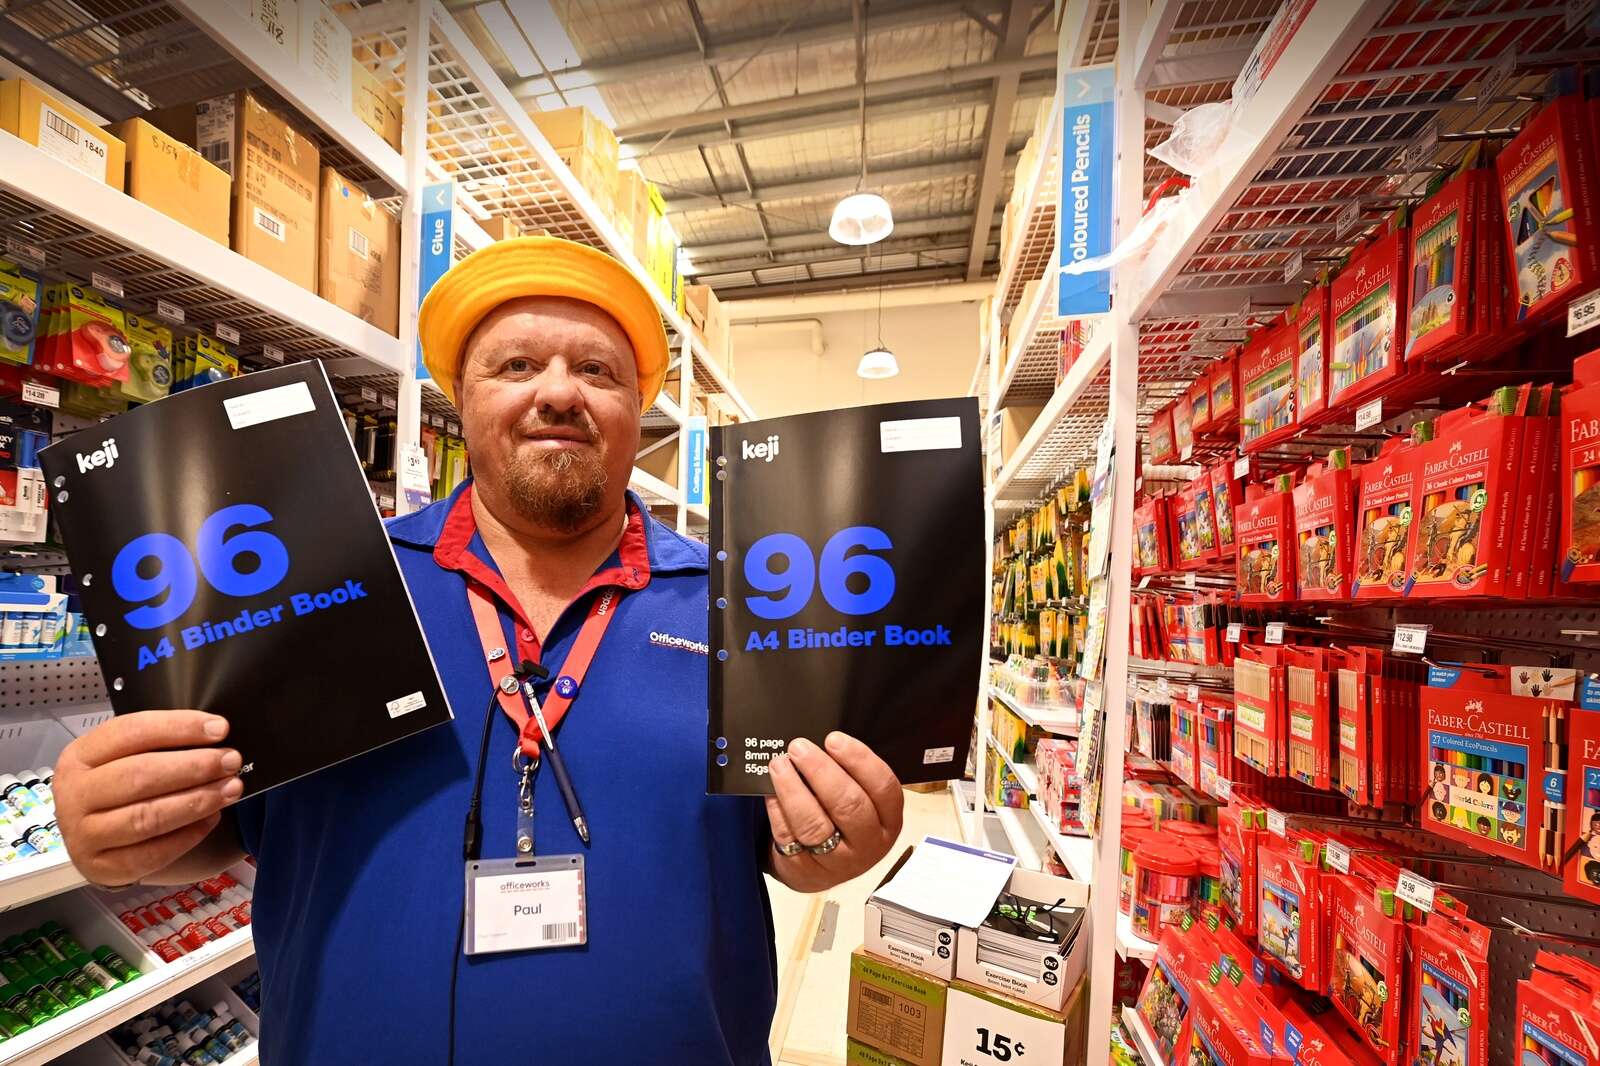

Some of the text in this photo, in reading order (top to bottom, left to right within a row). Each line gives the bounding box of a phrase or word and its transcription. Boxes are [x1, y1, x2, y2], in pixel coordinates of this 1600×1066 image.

[84, 139, 104, 158] 1840
[1069, 113, 1092, 267] oloured Pencils
[430, 218, 444, 256] Glue
[1335, 264, 1391, 315] FABER-CASTELL
[1570, 418, 1600, 443] FAB
[76, 437, 119, 474] keji
[742, 434, 780, 463] keji
[1583, 449, 1595, 463] 24
[1424, 447, 1490, 476] FABER-CASTELL
[1364, 472, 1414, 494] FABER-CASTELL
[111, 503, 290, 631] 96
[743, 526, 896, 620] 96
[137, 578, 368, 672] A4 Binder Book
[649, 631, 709, 653] Officeworks
[745, 625, 952, 651] A4 Binder Book
[1428, 708, 1530, 740] FABER-CASTELL
[744, 737, 784, 751] 96 page
[744, 750, 769, 760] 8mm
[1432, 734, 1498, 753] 27 Colored EcoPencils
[744, 763, 770, 775] 55gs
[1550, 777, 1557, 788] 6
[500, 880, 550, 891] officeworks
[514, 904, 542, 916] Paul
[1336, 897, 1387, 957] FABER-CASTELL
[888, 944, 925, 961] Exercise Book
[1420, 946, 1470, 985] FABER-CASTELL
[985, 970, 1028, 989] Exercise Book
[899, 1003, 921, 1019] 1003
[1522, 1004, 1589, 1054] FABER-CASTELL
[976, 1027, 1025, 1062] 15¢
